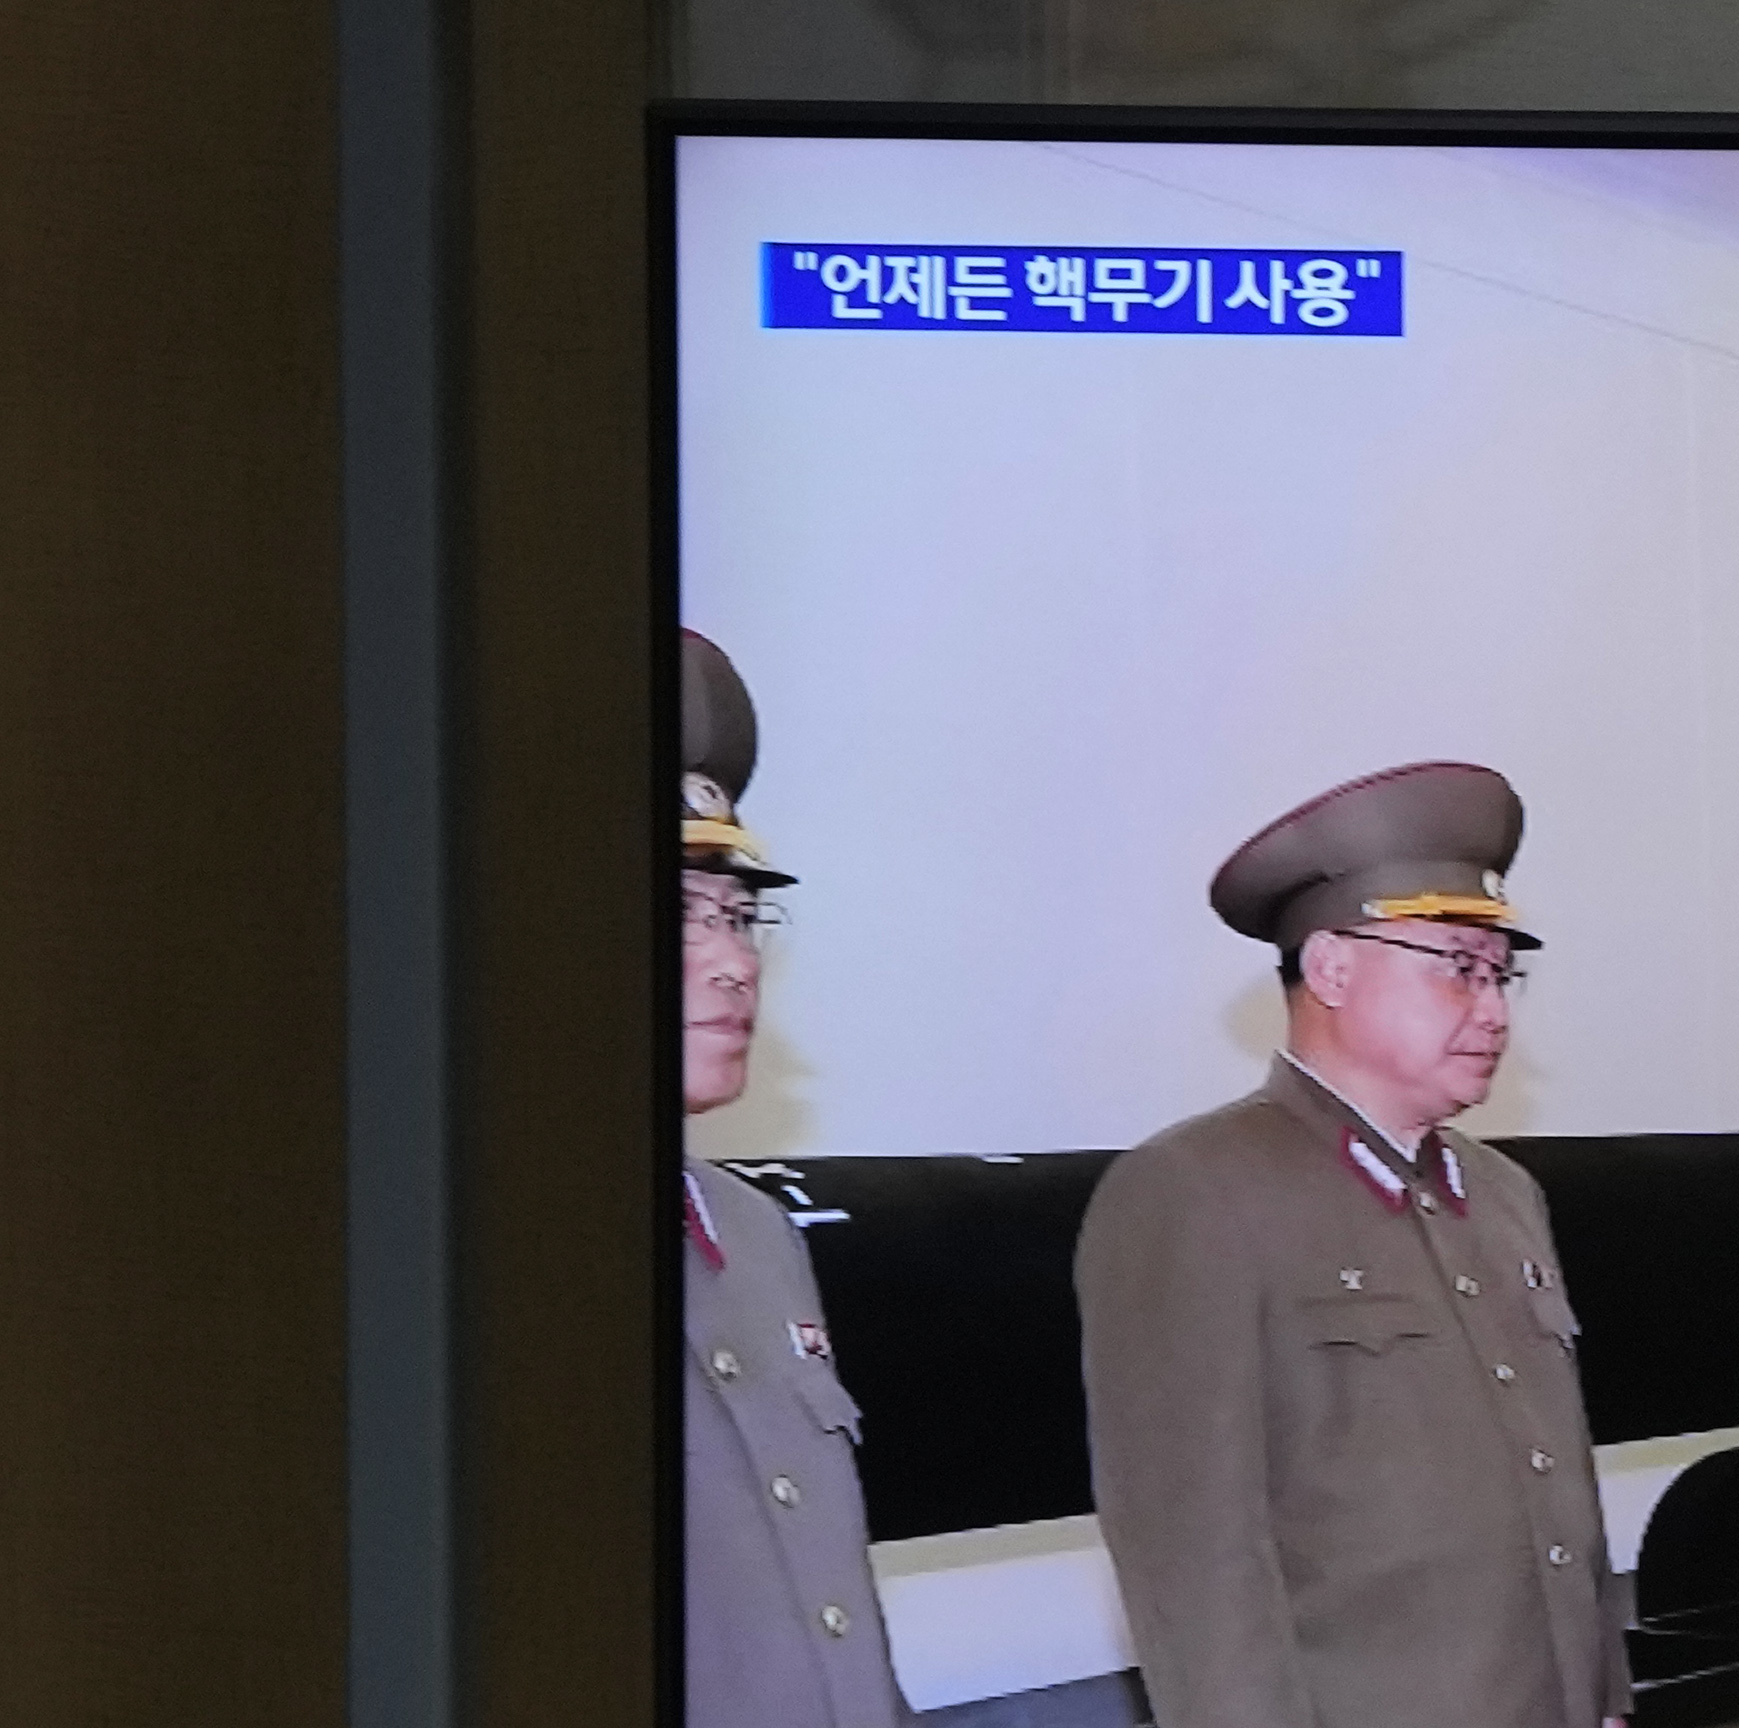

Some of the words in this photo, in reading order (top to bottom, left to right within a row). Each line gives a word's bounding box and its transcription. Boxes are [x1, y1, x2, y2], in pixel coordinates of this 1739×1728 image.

[791, 250, 1013, 322] "언제든
[1023, 255, 1214, 325] 핵무기
[1223, 256, 1382, 328] 사용"
